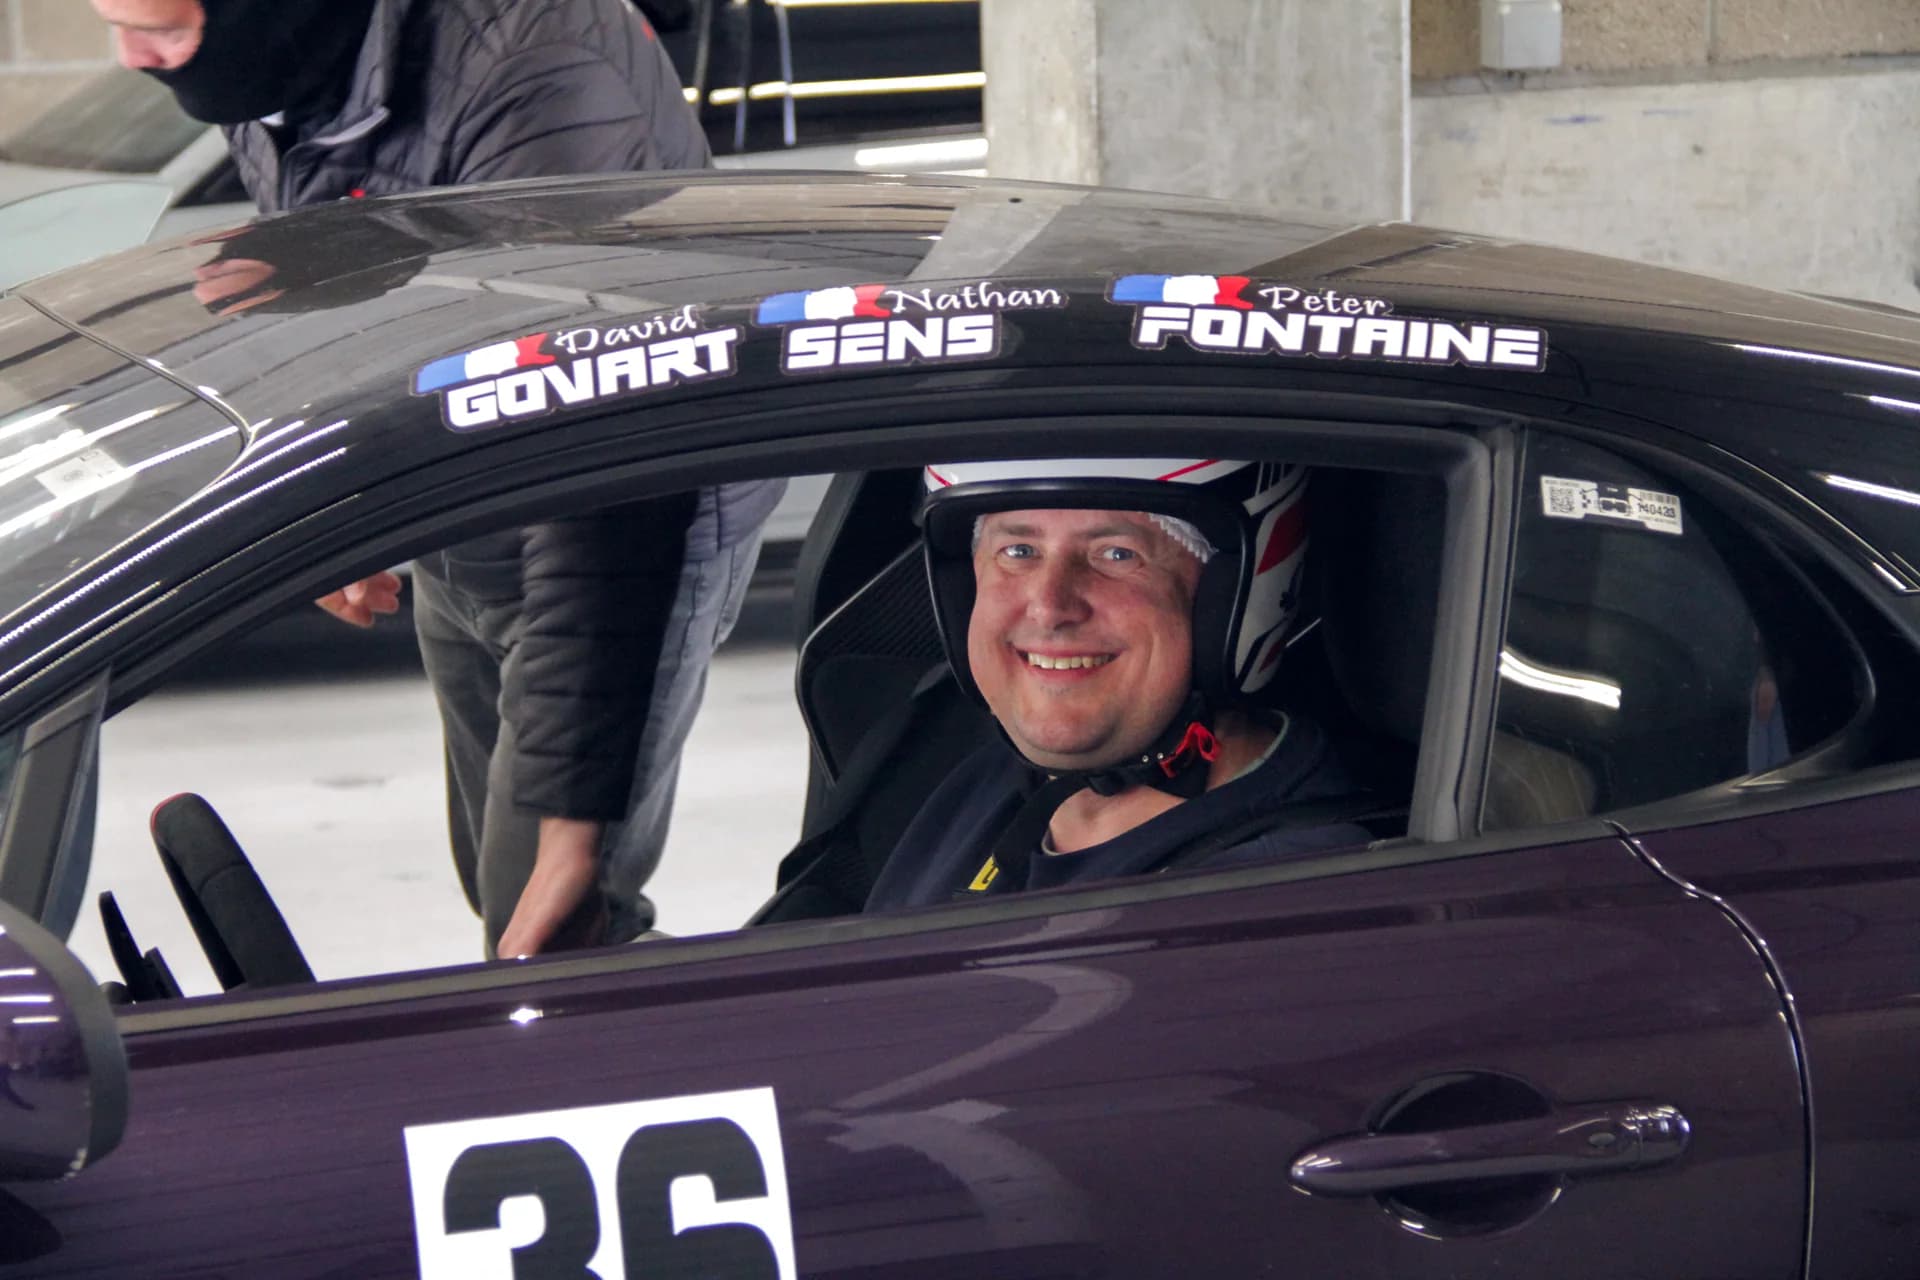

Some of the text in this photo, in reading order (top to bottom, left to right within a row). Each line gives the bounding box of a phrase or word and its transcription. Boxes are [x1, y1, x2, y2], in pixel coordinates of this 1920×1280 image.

[884, 282, 1060, 313] Nathan
[1258, 286, 1387, 313] Peter
[555, 304, 697, 354] David
[787, 314, 993, 369] SENS
[1138, 306, 1540, 366] FONTAINE
[447, 328, 738, 427] GOVART
[443, 1117, 781, 1280] 36
